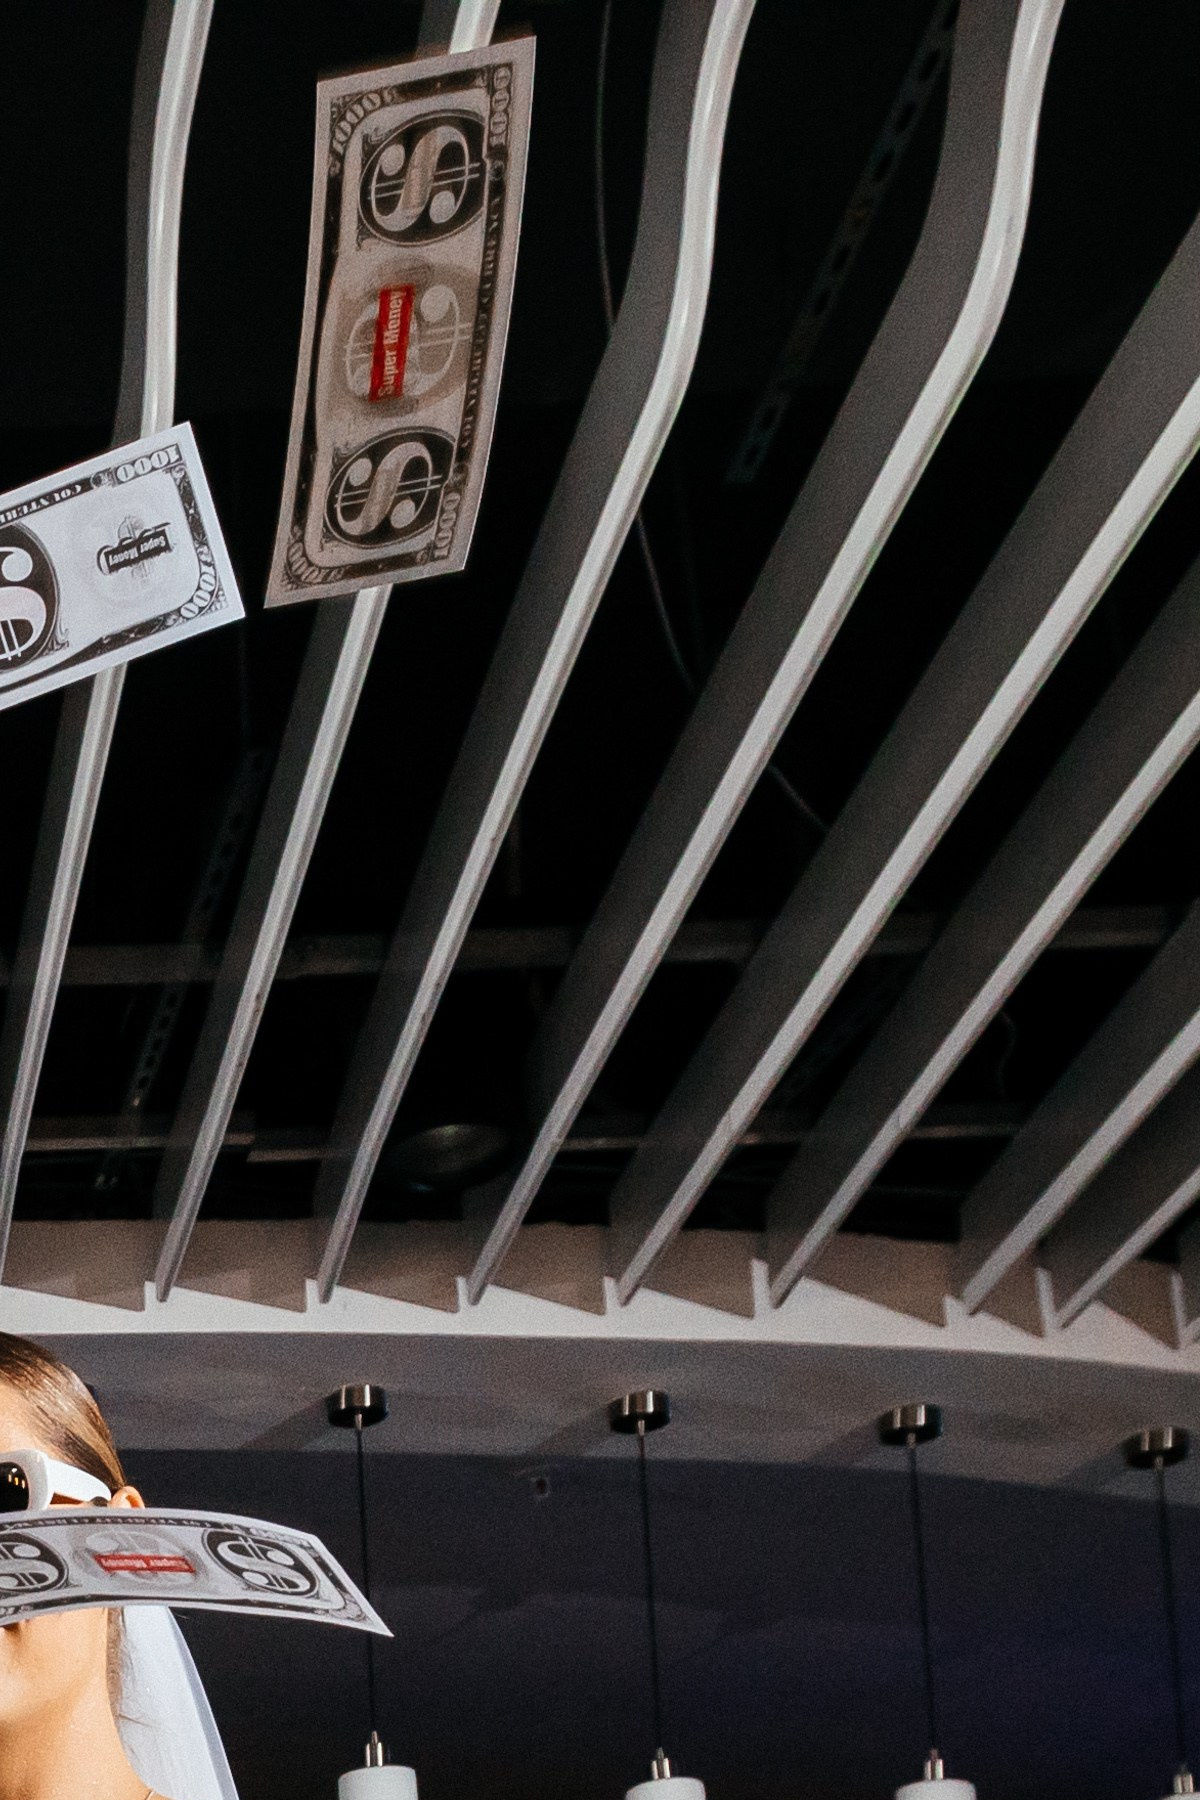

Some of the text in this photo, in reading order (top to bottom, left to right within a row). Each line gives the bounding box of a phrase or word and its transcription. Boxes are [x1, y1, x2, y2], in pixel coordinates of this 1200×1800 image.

[378, 290, 406, 397] Super Money
[116, 448, 181, 483] 1000
[107, 535, 166, 567] Super Money
